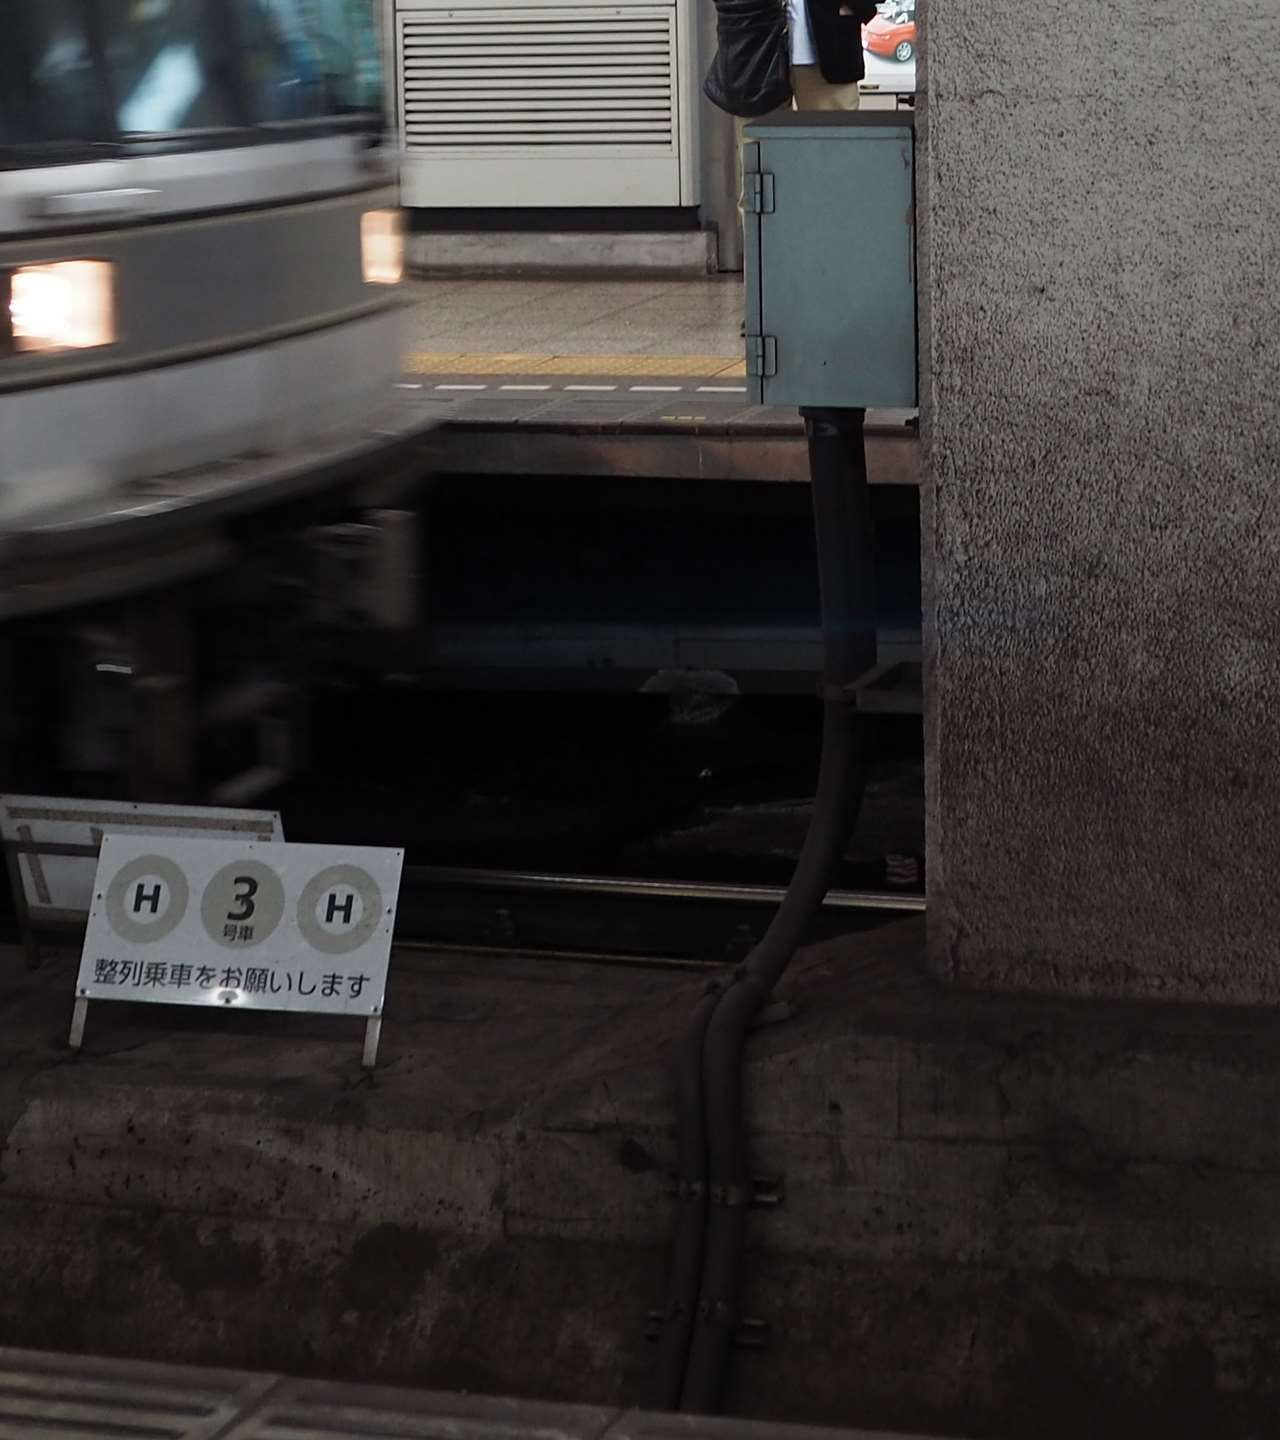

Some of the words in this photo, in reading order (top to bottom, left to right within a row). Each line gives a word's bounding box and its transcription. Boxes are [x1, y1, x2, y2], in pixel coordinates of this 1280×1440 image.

[132, 883, 161, 913] H
[227, 875, 259, 921] 3
[325, 893, 354, 924] H
[223, 924, 255, 942] 号車
[93, 958, 370, 999] 整列乗車をお願いします
